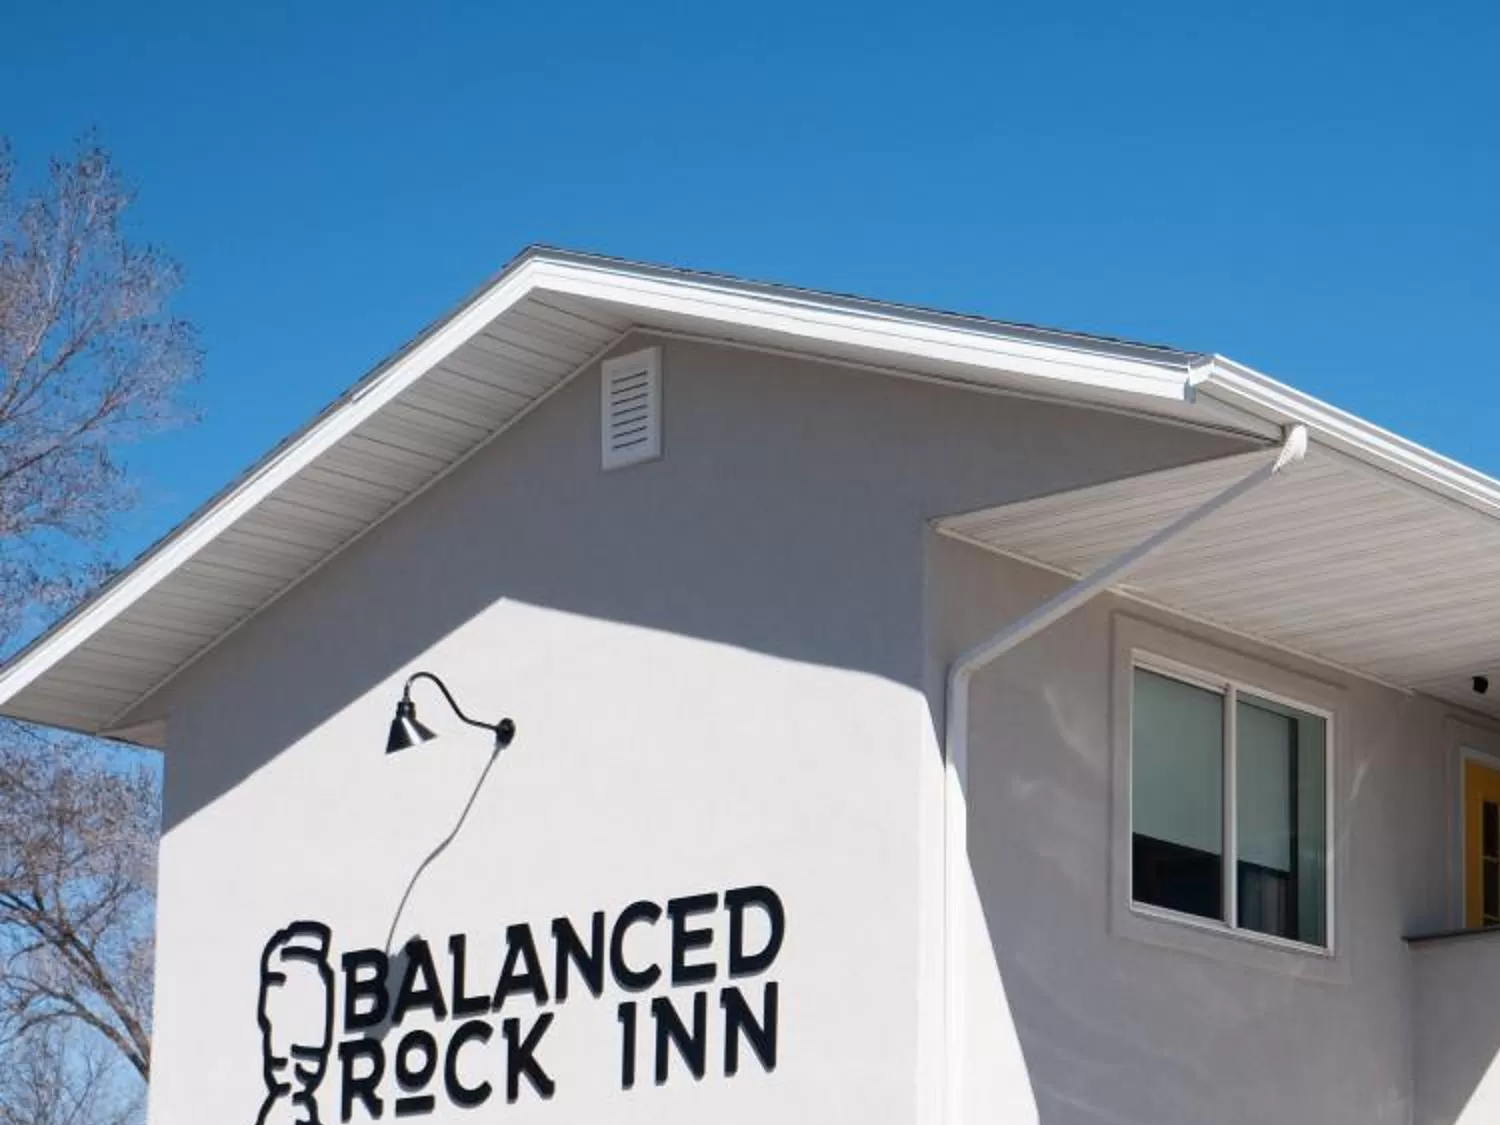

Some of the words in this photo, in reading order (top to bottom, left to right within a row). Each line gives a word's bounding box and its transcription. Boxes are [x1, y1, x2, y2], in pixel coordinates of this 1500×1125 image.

[341, 885, 785, 1032] BALANCED
[338, 1012, 555, 1122] ROCK
[618, 981, 778, 1090] INN
